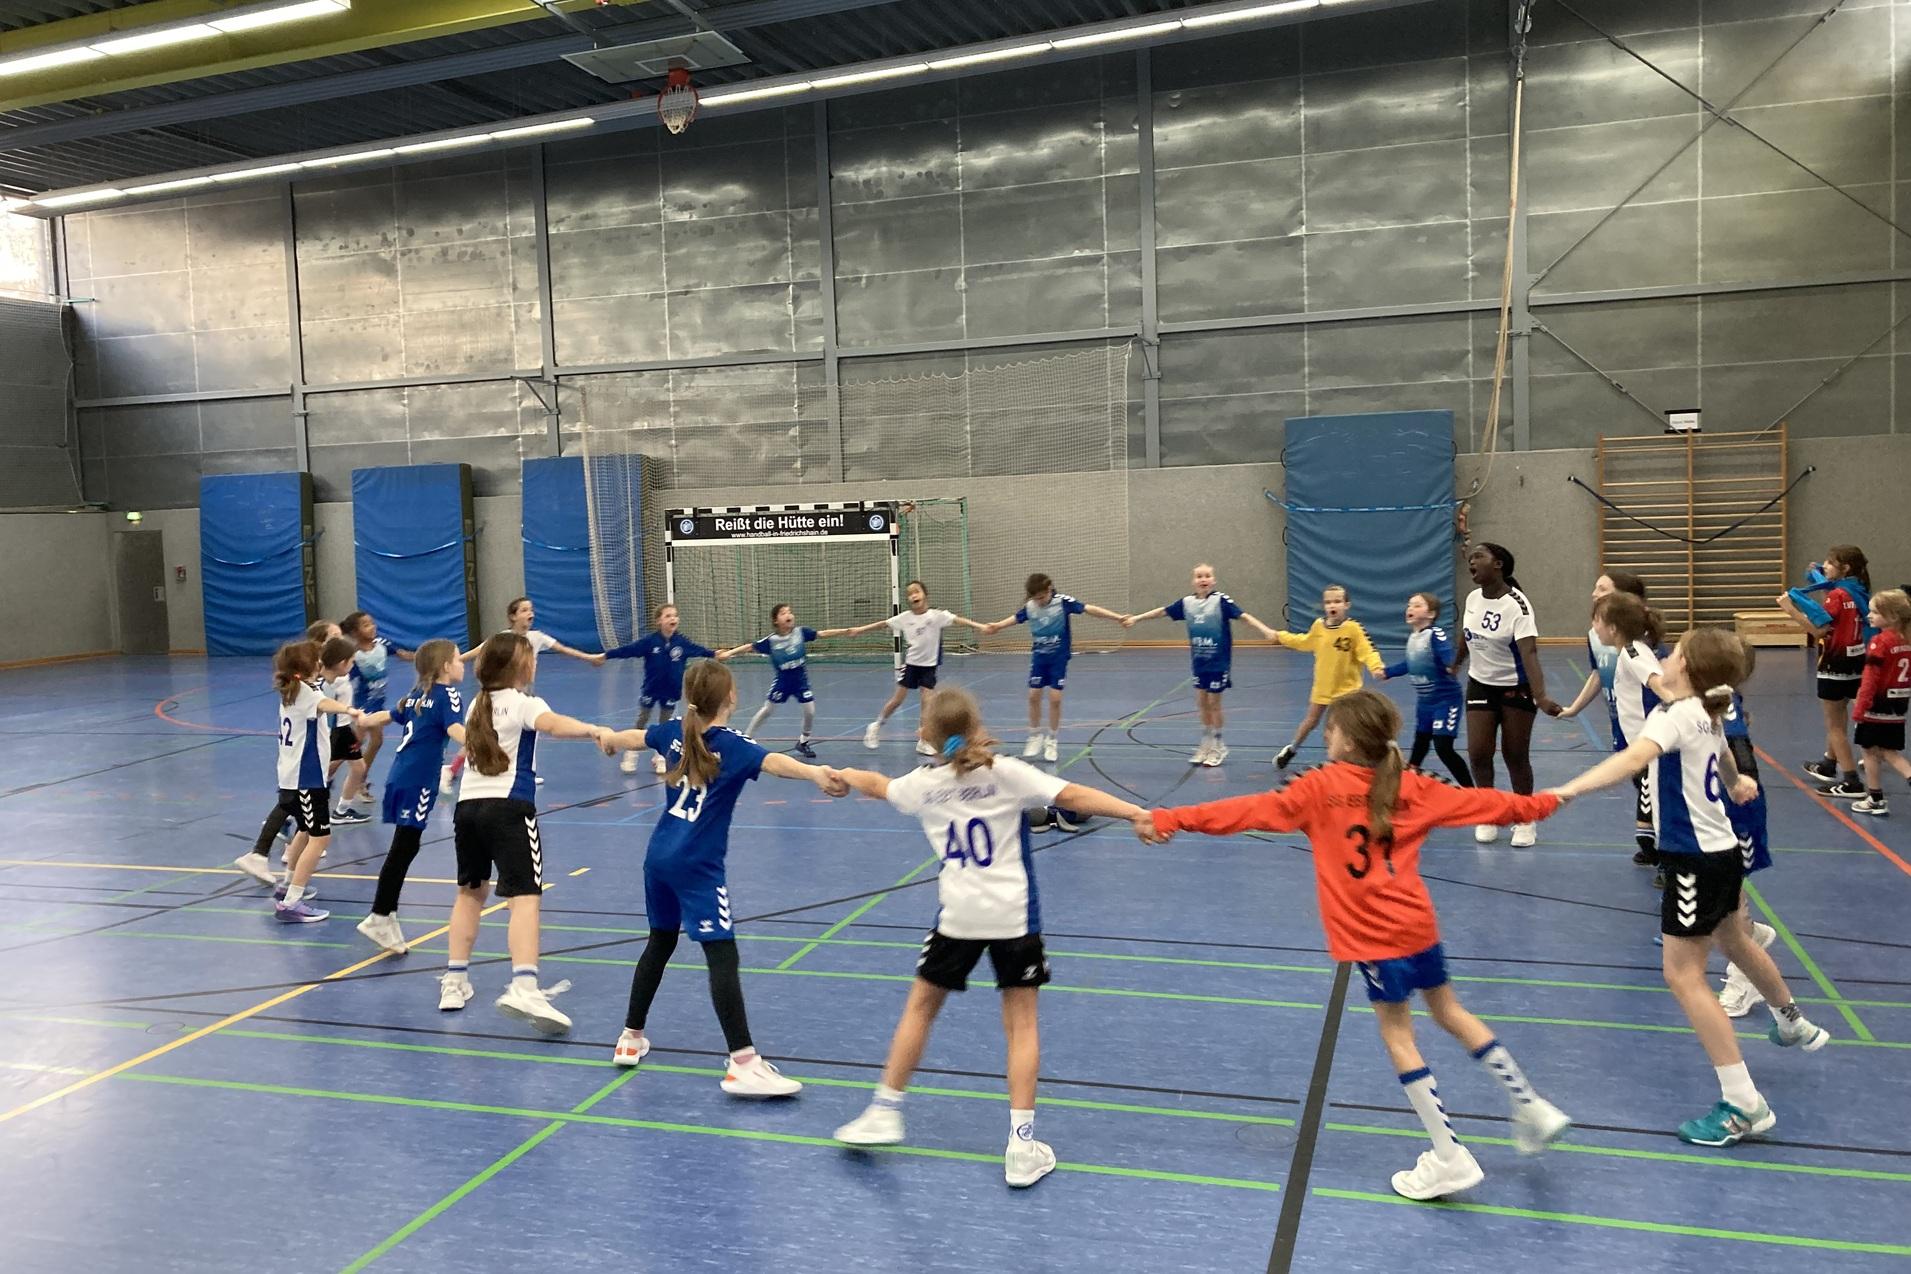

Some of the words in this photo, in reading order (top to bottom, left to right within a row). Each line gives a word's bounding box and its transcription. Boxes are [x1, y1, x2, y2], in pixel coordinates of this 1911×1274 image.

[715, 518, 751, 531] Reißt
[754, 516, 774, 530] die
[778, 514, 814, 529] Hütte
[817, 513, 844, 527] ein!
[731, 529, 828, 539] www.handball-in-friedrichshain.de
[1481, 610, 1502, 632] 53
[1333, 636, 1353, 652] 43
[668, 774, 708, 823] 23
[942, 817, 994, 868] 40
